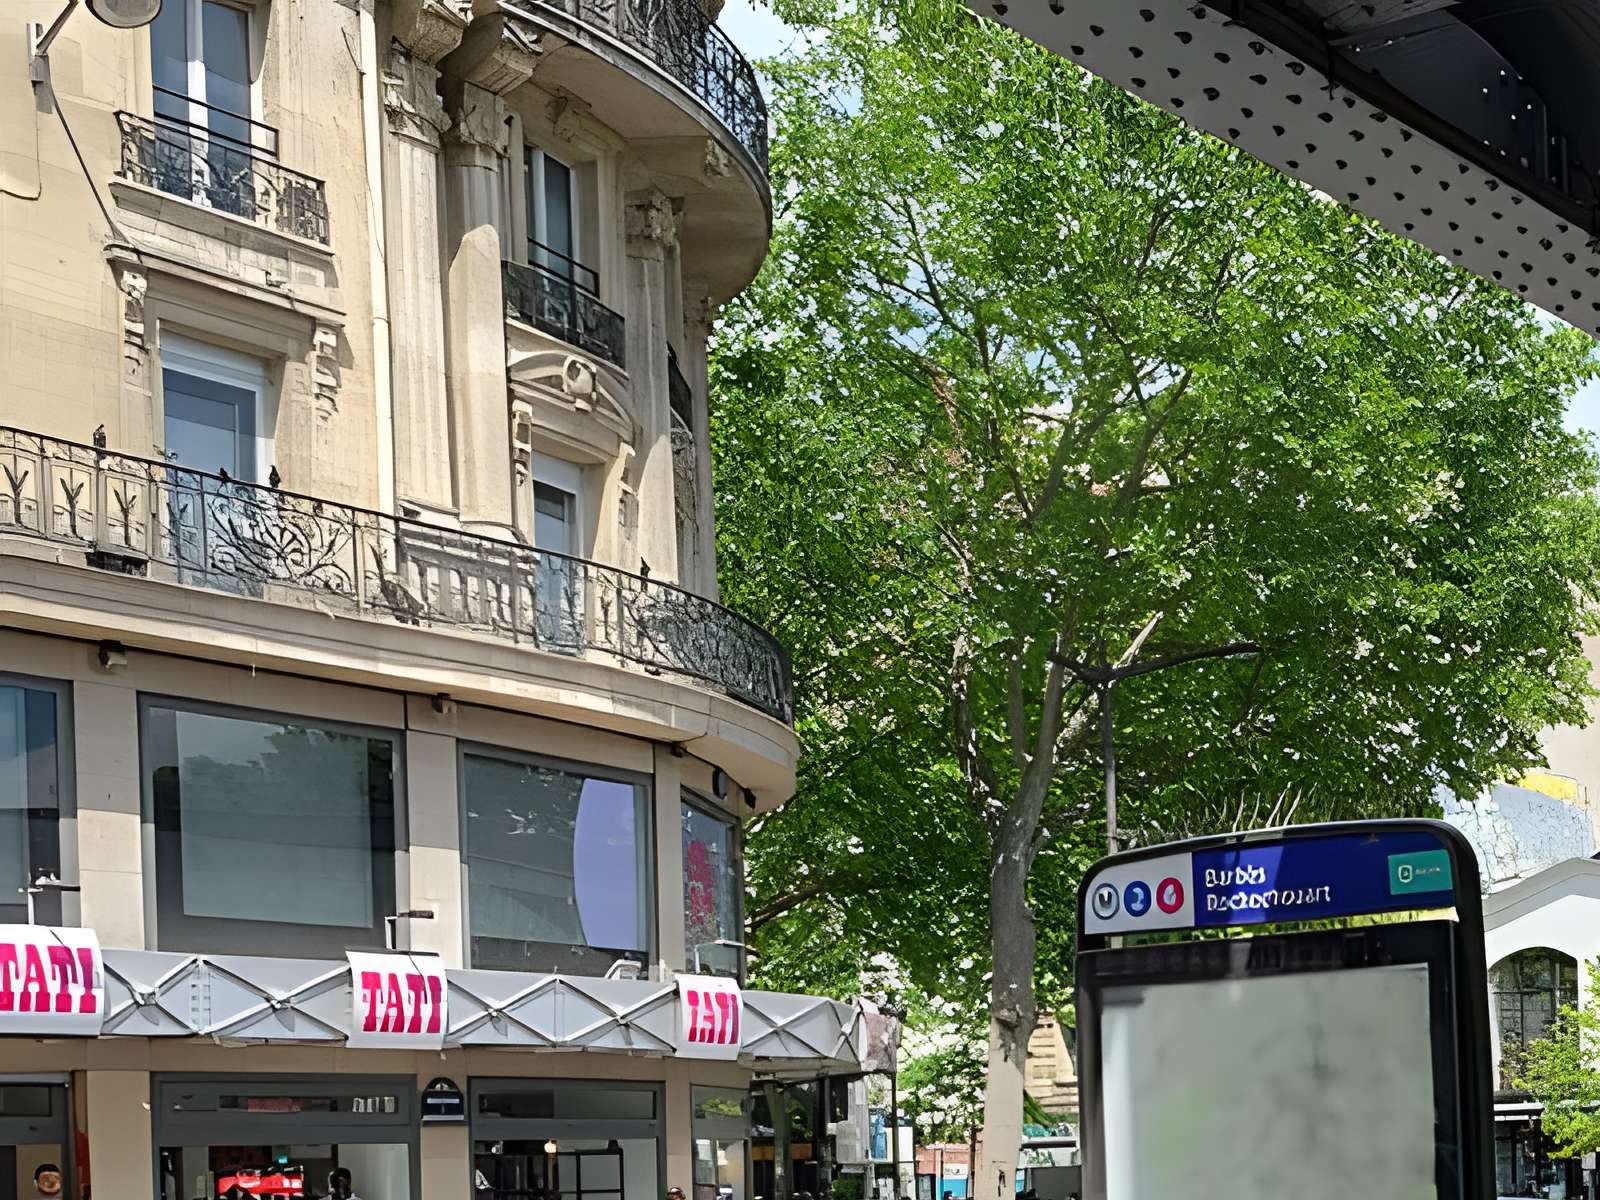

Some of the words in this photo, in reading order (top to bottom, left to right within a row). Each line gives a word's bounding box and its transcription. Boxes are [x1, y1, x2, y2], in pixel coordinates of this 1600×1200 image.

[0, 943, 96, 1013] TATI
[361, 971, 442, 1034] TATI
[687, 990, 739, 1044] TATI
